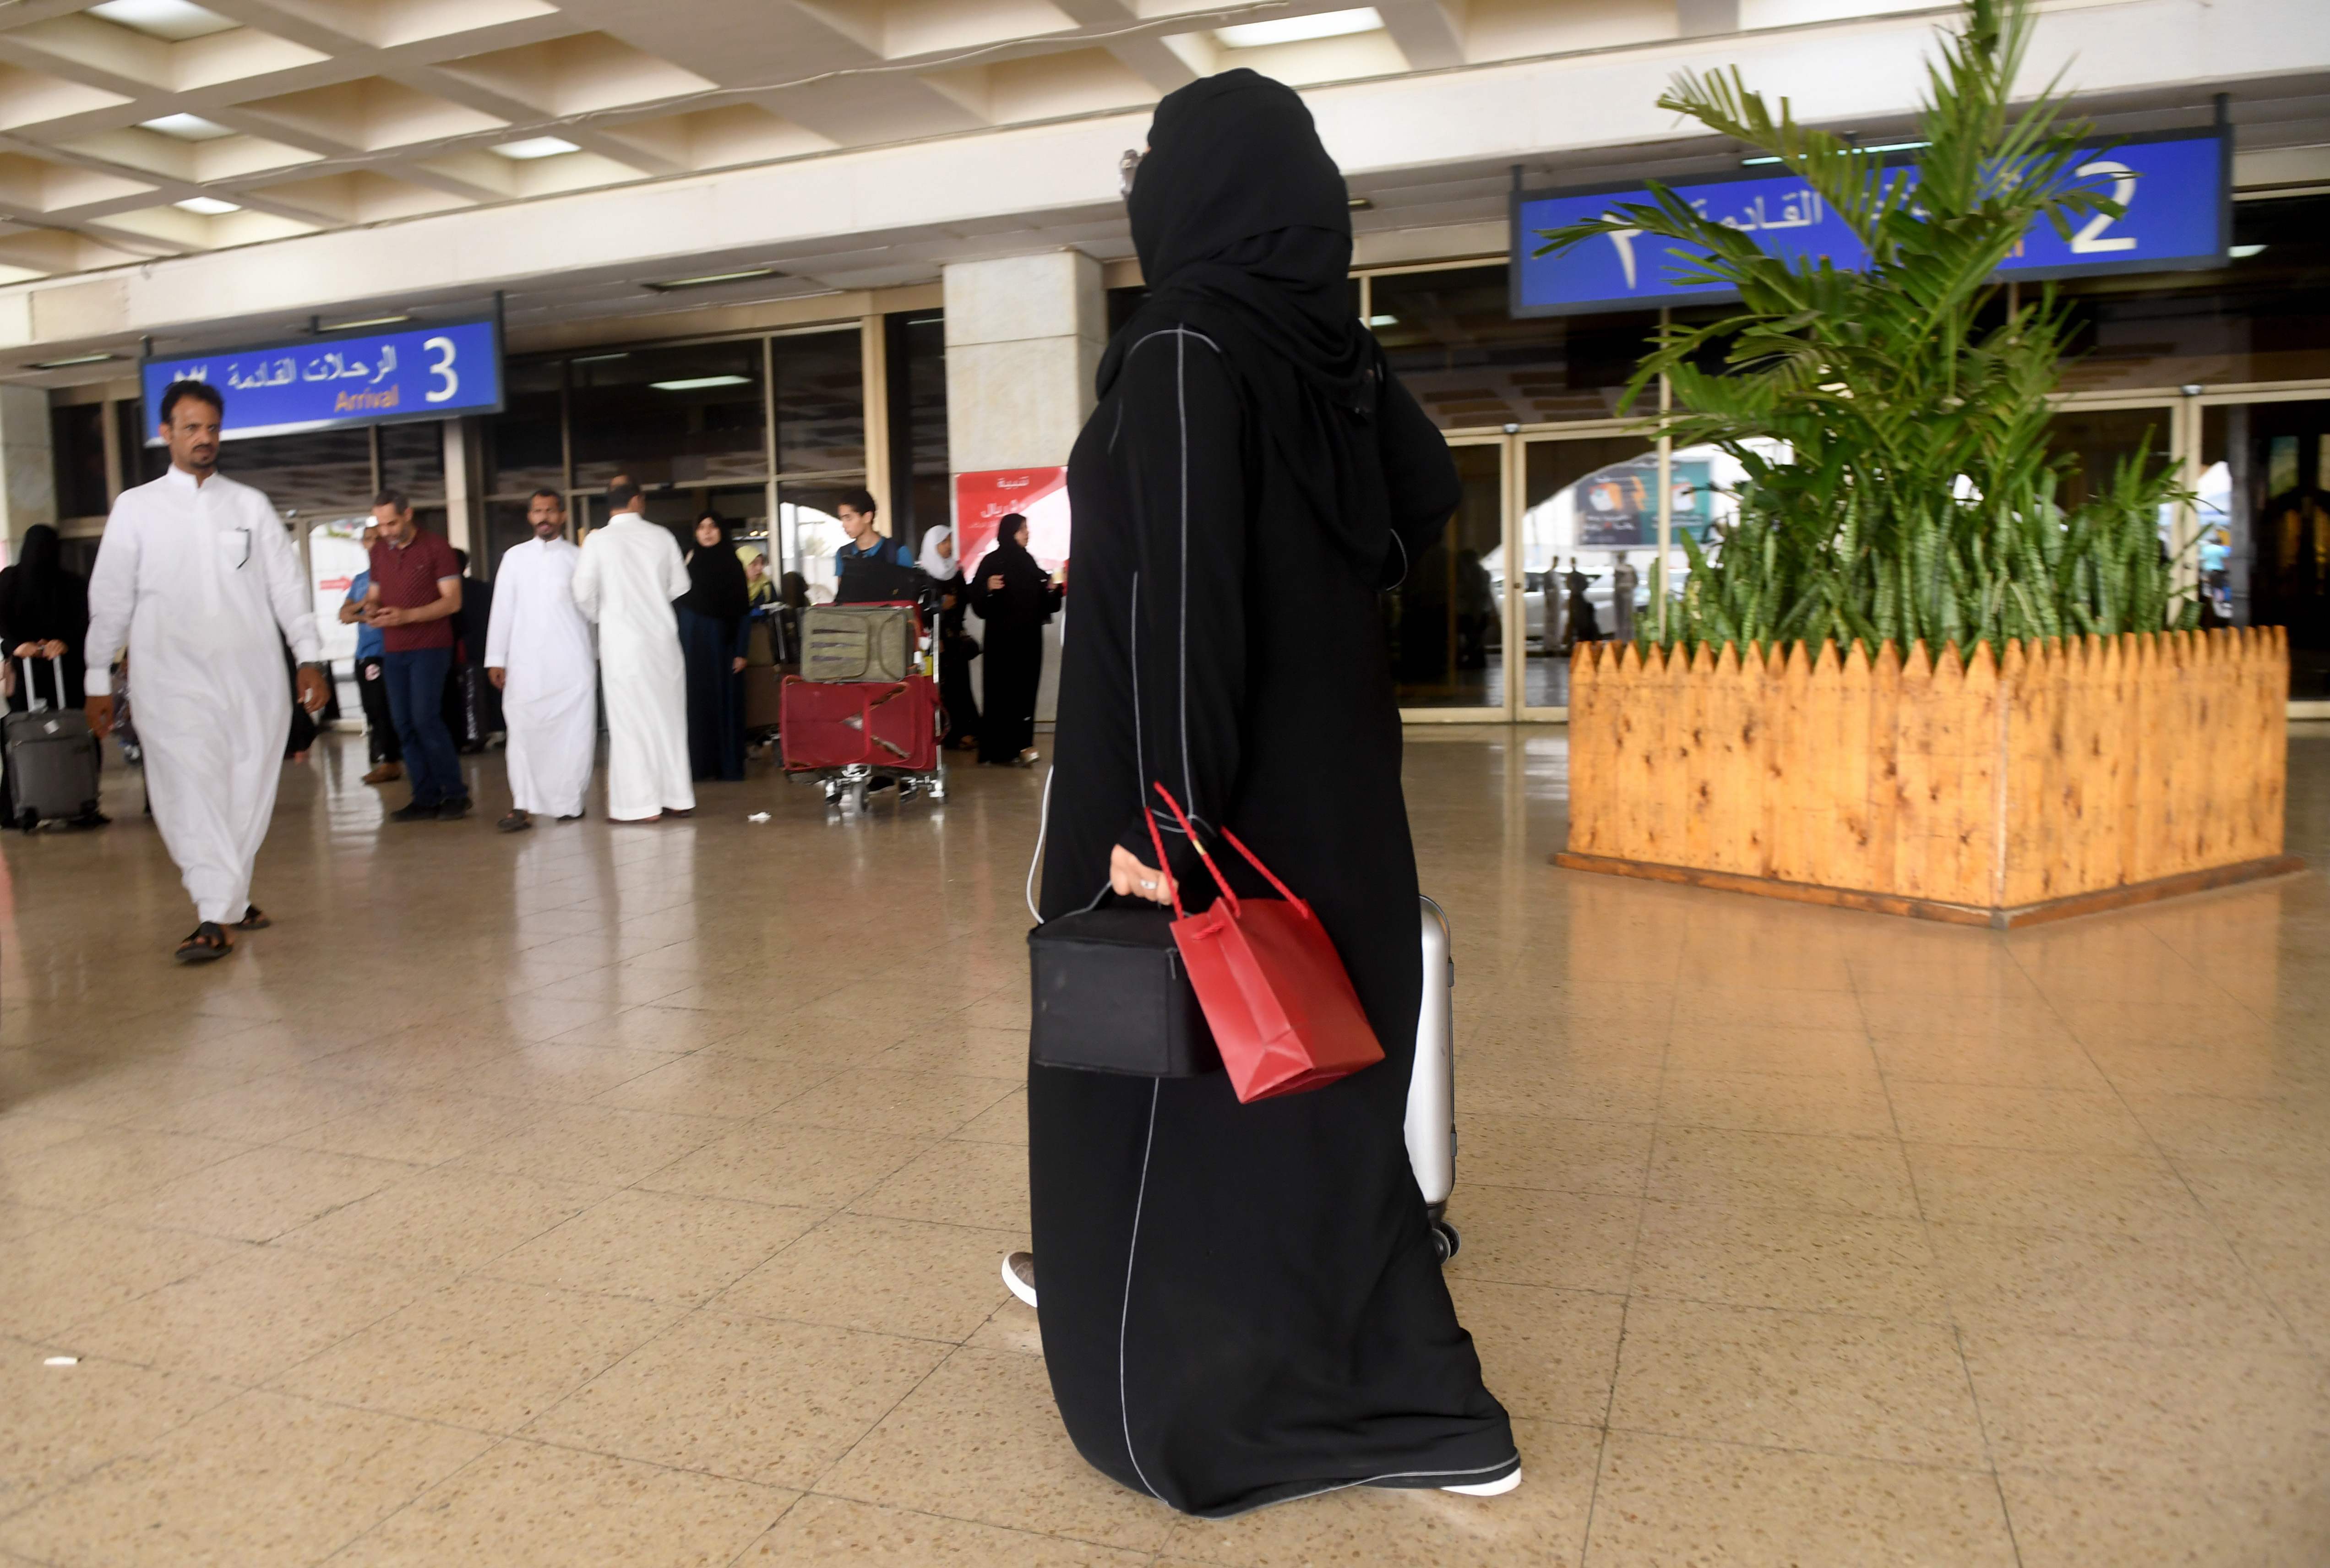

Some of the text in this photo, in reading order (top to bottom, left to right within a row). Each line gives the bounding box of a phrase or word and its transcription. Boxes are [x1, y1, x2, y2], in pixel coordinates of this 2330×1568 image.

[2071, 160, 2137, 253] 2
[227, 357, 297, 390] القادمة
[301, 344, 397, 384] الرحلات
[423, 336, 458, 403] 3
[334, 383, 400, 412] Arrival
